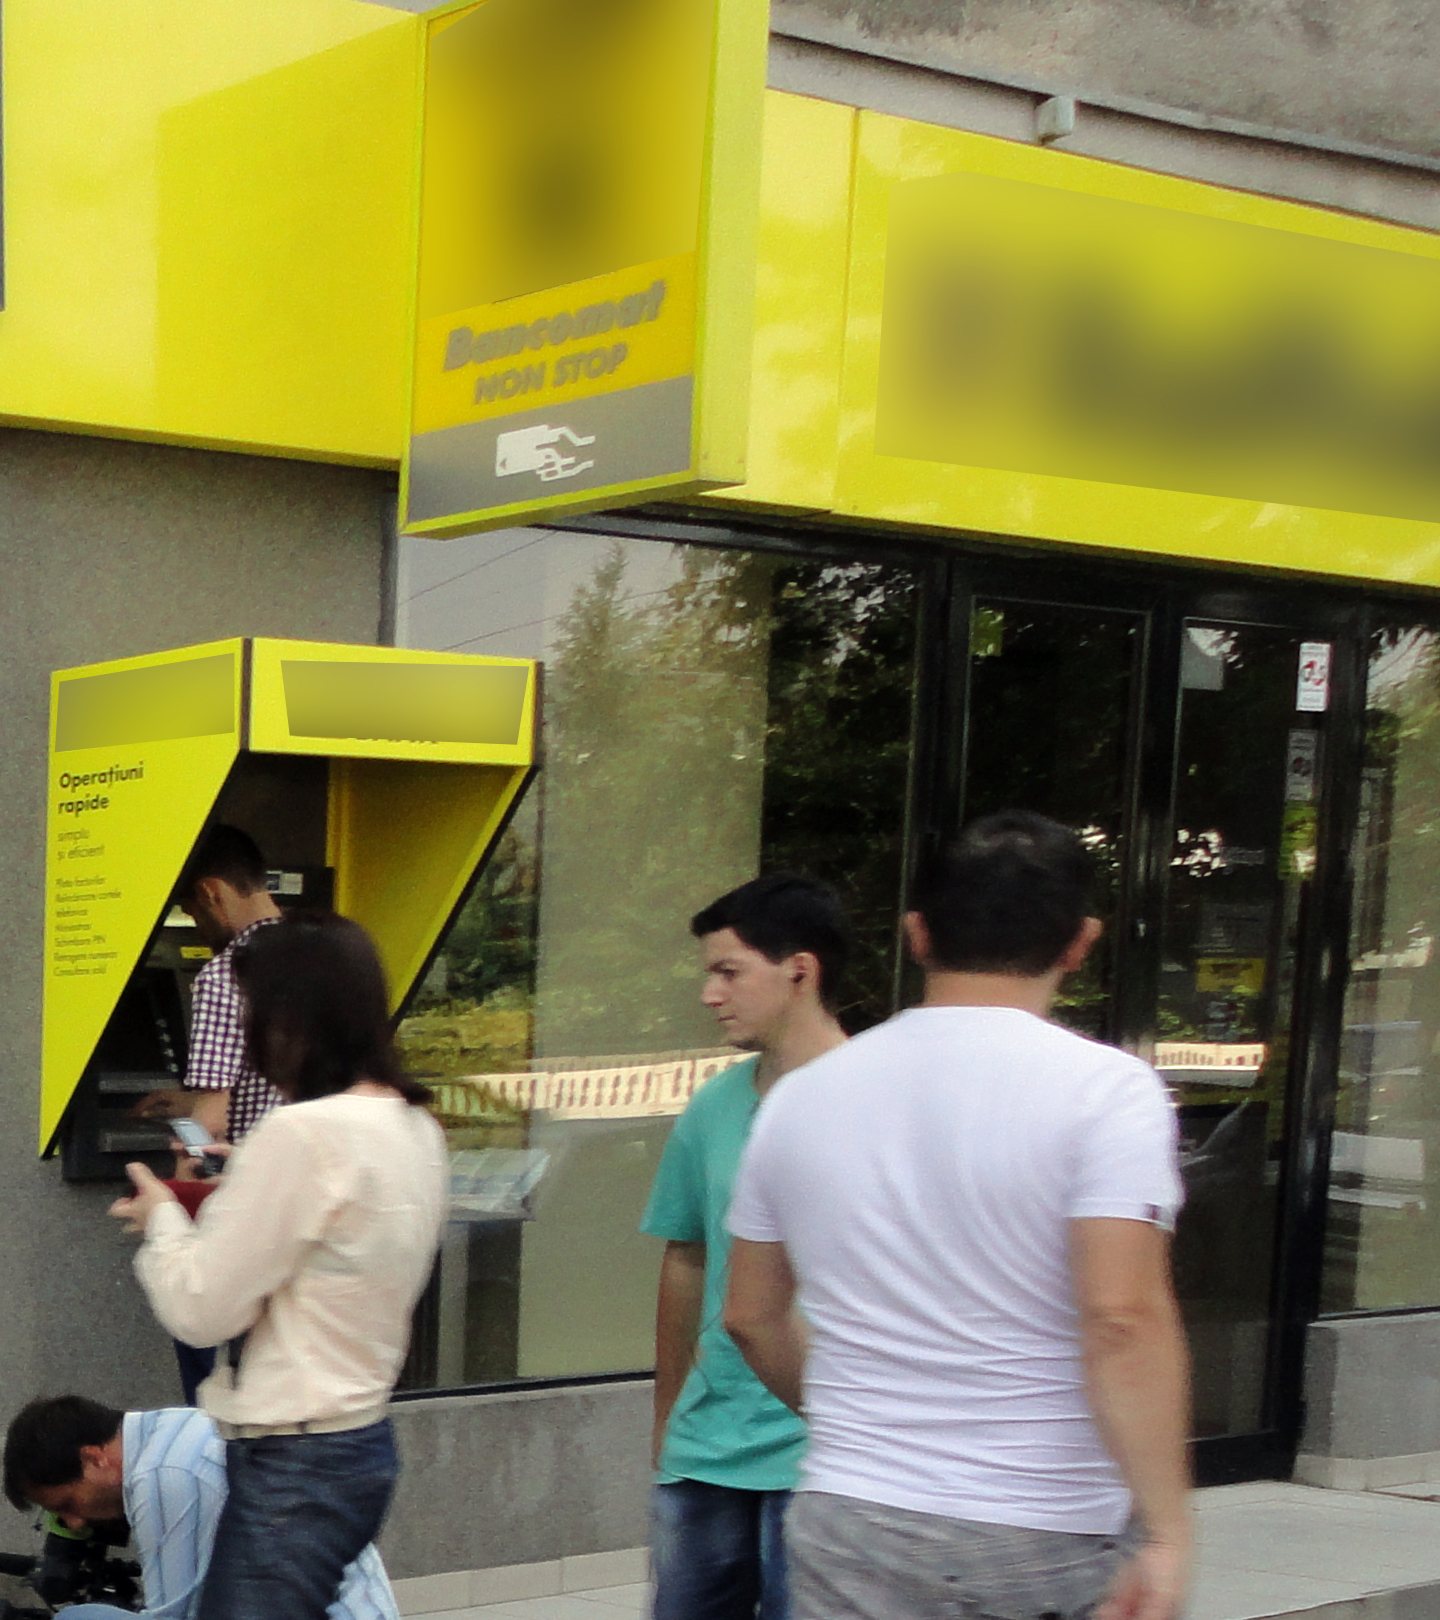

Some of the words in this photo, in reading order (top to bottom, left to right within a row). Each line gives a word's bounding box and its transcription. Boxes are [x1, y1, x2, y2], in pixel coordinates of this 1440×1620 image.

[444, 279, 667, 372] Bancomat
[474, 362, 547, 404] NON
[553, 342, 629, 388] STOP
[58, 793, 110, 818] rapide
